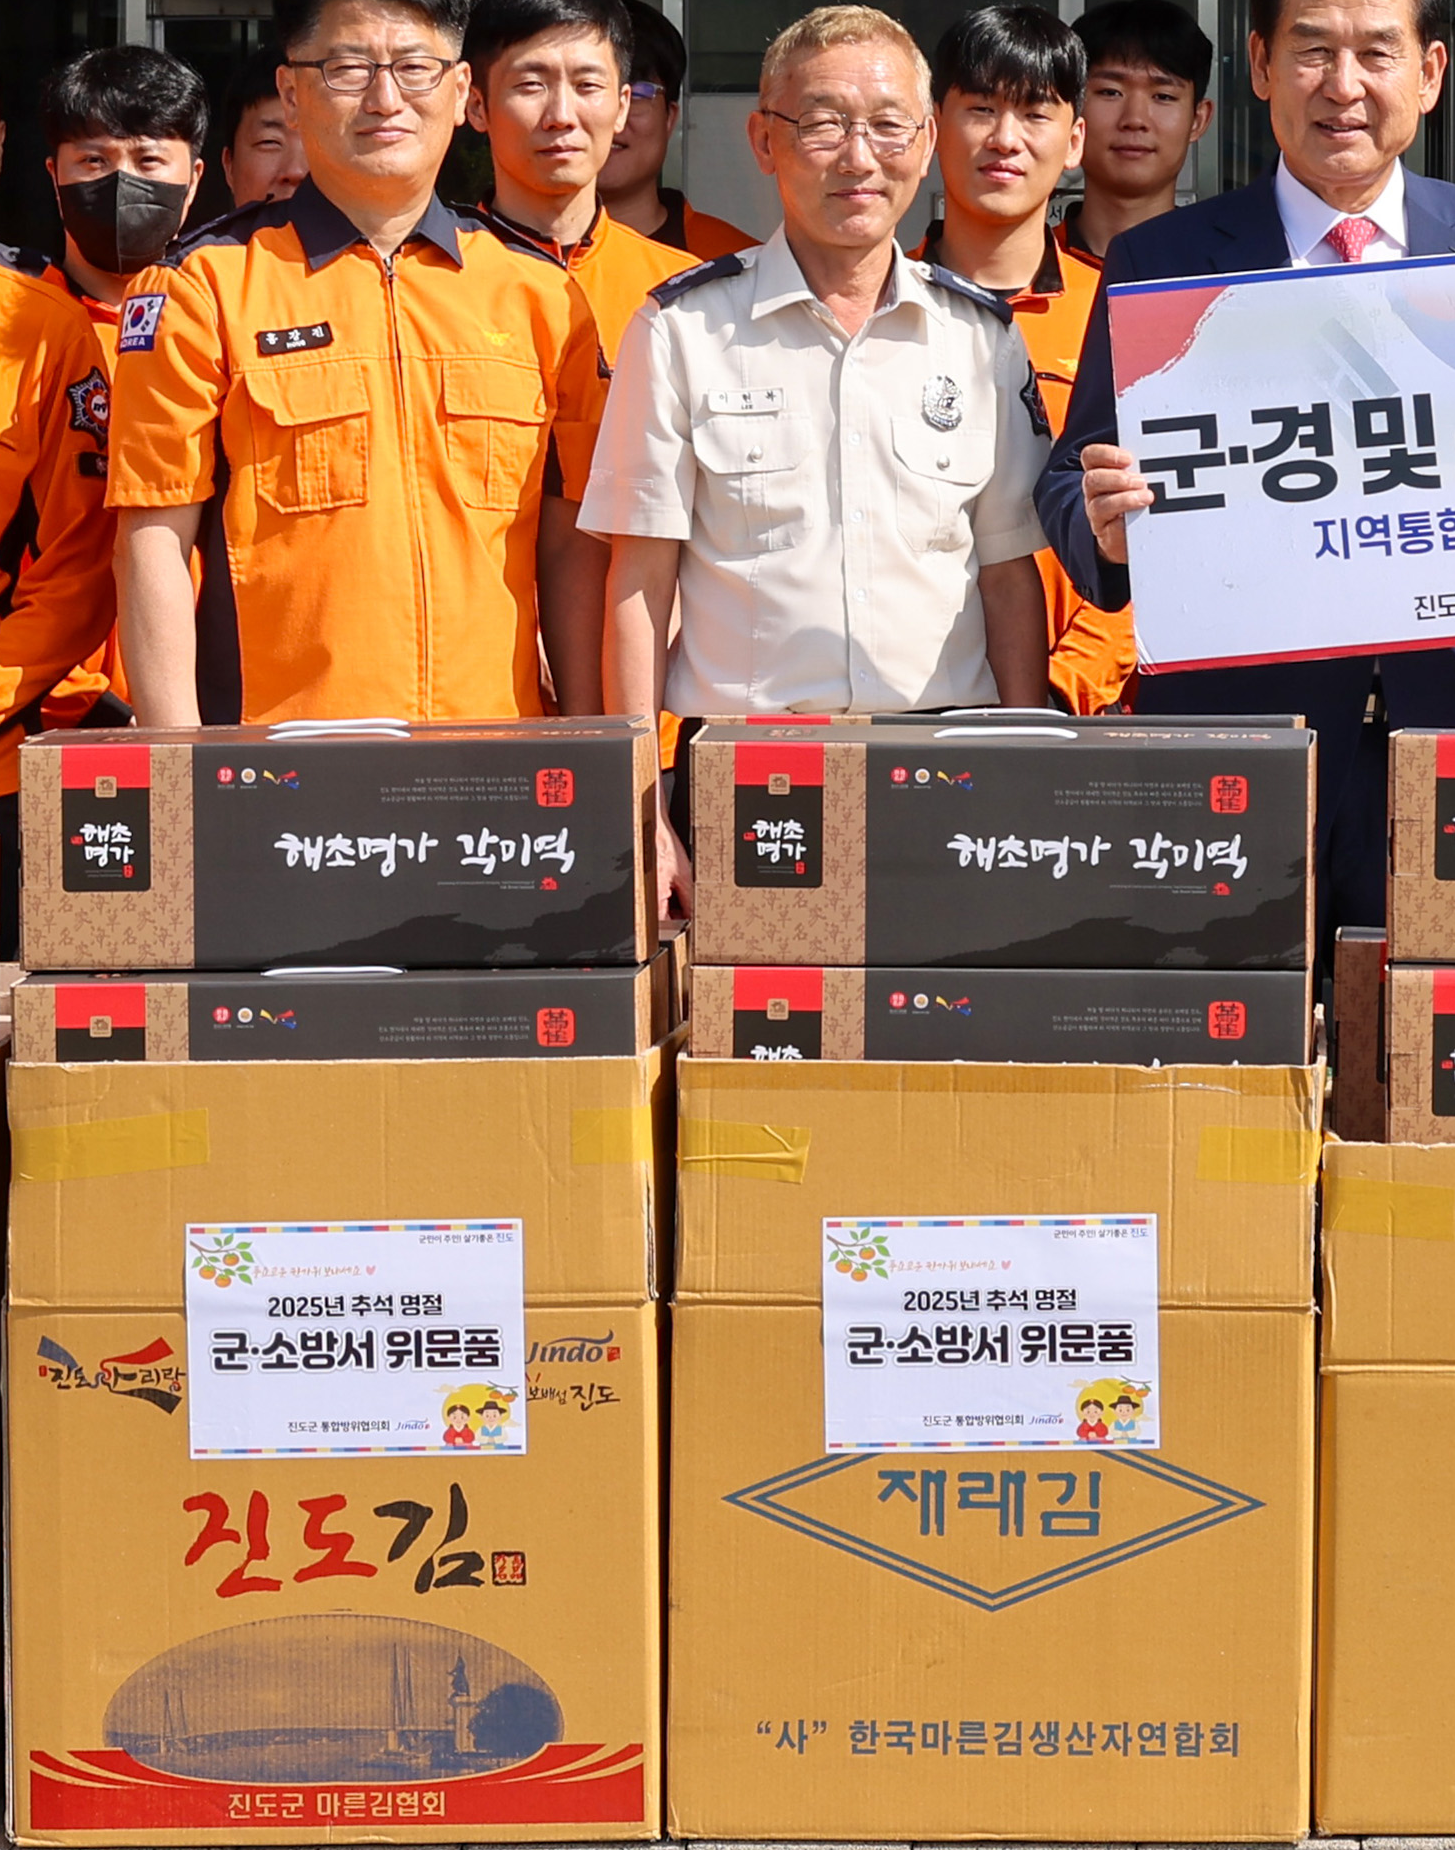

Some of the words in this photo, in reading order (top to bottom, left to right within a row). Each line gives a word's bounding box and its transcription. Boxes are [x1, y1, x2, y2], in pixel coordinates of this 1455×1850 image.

[1140, 402, 1340, 514] 군·경
[1354, 395, 1440, 490] 및
[80, 823, 131, 845] 해초
[752, 820, 804, 839] 해초
[85, 844, 134, 866] 명가
[274, 832, 438, 877] 해초명가
[757, 840, 806, 862] 명가
[947, 834, 1111, 879] 해초명가
[496, 1232, 514, 1244] 진도
[1130, 1227, 1148, 1238] 진도
[269, 1296, 344, 1317] 2025년
[352, 1295, 393, 1316] 추석
[401, 1295, 442, 1315] 명절
[904, 1291, 979, 1311] 2025년
[987, 1290, 1028, 1311] 추석
[1036, 1289, 1076, 1310] 명절
[213, 1330, 374, 1370] 군·소방서
[387, 1329, 500, 1368] 위문품
[848, 1325, 1008, 1364] 군·소방서
[1021, 1324, 1133, 1362] 위문품
[570, 1383, 620, 1411] 진도
[288, 1421, 318, 1433] 진도군
[321, 1420, 390, 1433] 통합방위협의회
[922, 1415, 953, 1427] 진도군
[955, 1414, 1024, 1427] 통합방위협의회
[877, 1469, 1101, 1536] 재래김
[182, 1482, 485, 1599] 진도김
[848, 1719, 1240, 1757] 한국마른김생산자연합회
[227, 1792, 304, 1819] 진도군
[317, 1791, 446, 1818] 마른김협회
